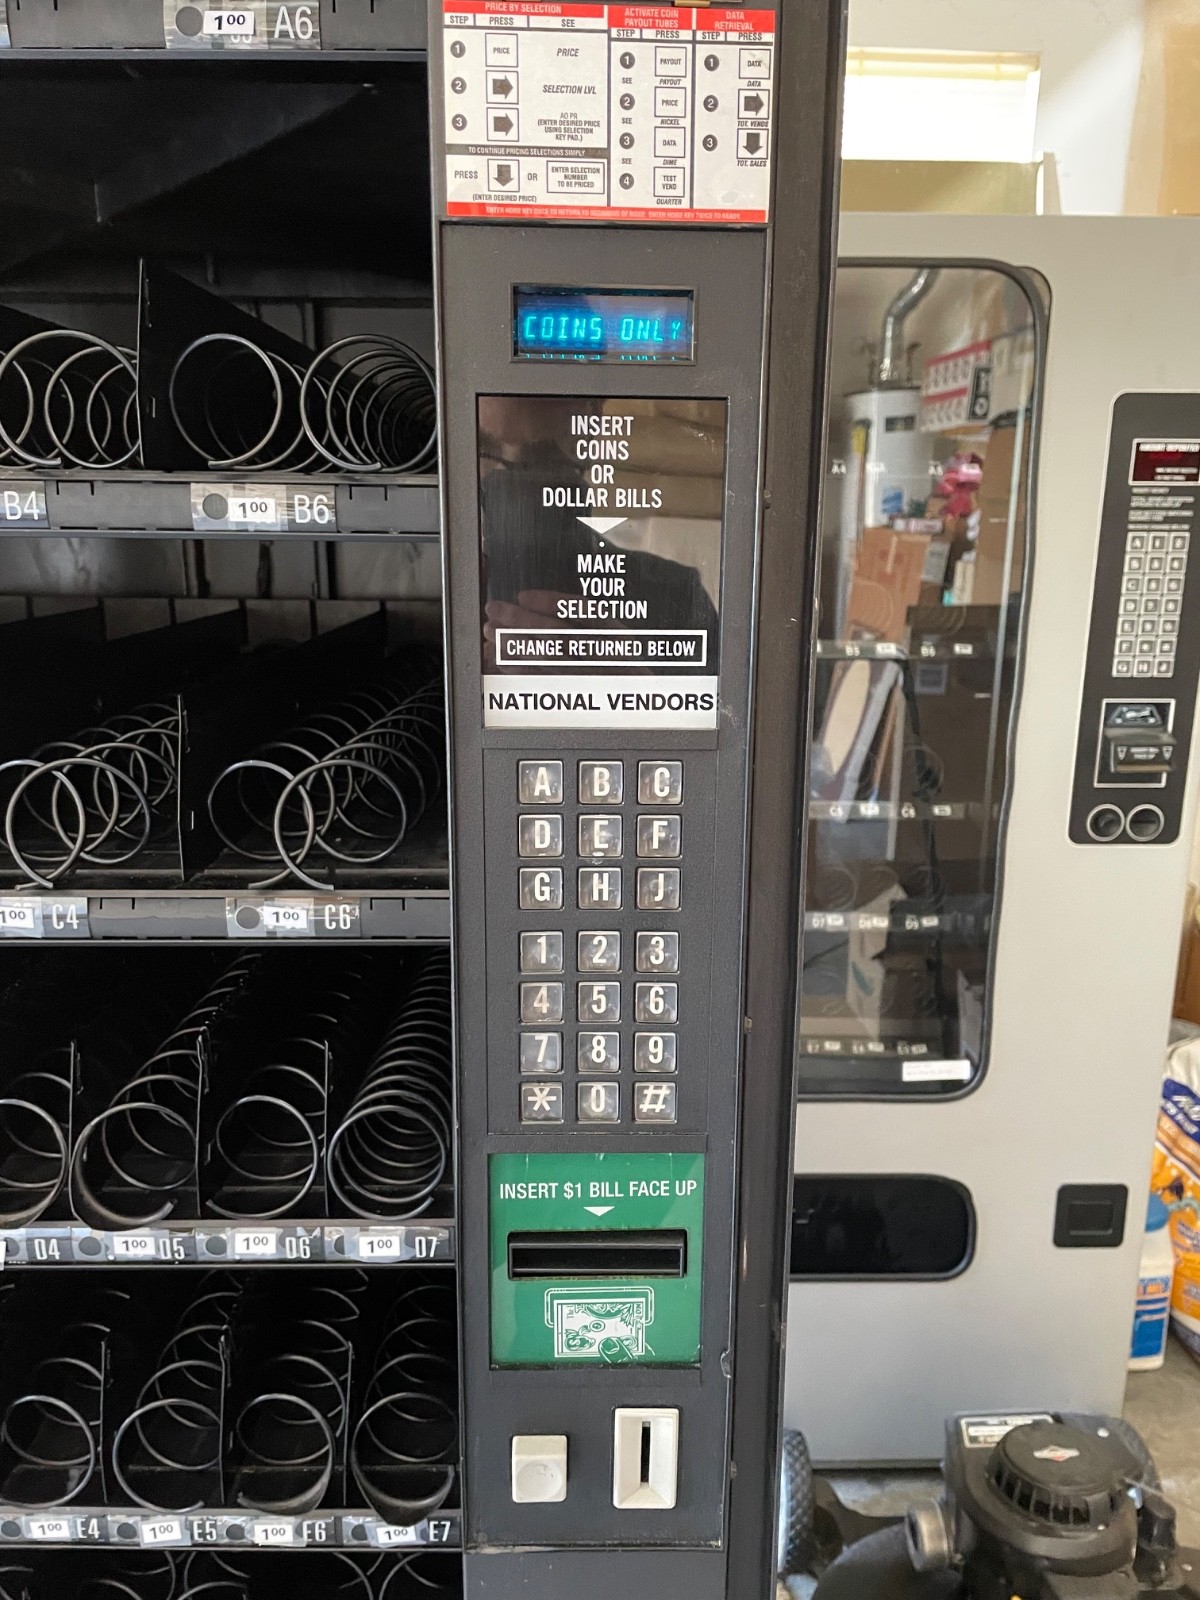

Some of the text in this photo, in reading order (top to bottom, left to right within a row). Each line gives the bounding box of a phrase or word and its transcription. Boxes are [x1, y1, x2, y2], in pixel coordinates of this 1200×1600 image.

[485, 2, 562, 14] PRICE BY SELECTION
[624, 8, 679, 18] ACTIVATE COIN
[726, 11, 745, 20] DATA
[273, 5, 313, 40] A6
[450, 15, 469, 24] STEP
[489, 17, 514, 26] PRESS
[561, 19, 576, 28] SEE
[624, 18, 679, 28] PAYOUT TUBES
[714, 22, 754, 31] RETRIEVAL
[616, 28, 635, 38] STEP
[655, 30, 680, 39] PRESS
[702, 31, 721, 40] STEP
[738, 32, 763, 41] PRESS
[556, 48, 580, 57] PRICE
[747, 60, 762, 68] DATA
[542, 84, 597, 95] SELECTION LVL
[659, 78, 682, 86] PAYOUT
[661, 99, 679, 107] PRICE
[660, 118, 680, 126] NICKEL
[468, 146, 586, 157] TO CONTINUE PRICING SELECTIONS SIMPLY
[662, 139, 677, 147] DATA
[621, 157, 632, 165] SEE
[454, 170, 479, 180] PRESS
[527, 172, 538, 181] OR
[557, 180, 565, 188] TO
[662, 175, 677, 183] TEST
[661, 183, 677, 191] VEND
[472, 193, 537, 203] (ENTER DESIRED PRICE)
[655, 198, 683, 206] QUARTER
[523, 316, 681, 342] COINS ONLY
[571, 415, 634, 436] INSERT
[576, 440, 630, 460] COINS
[591, 464, 615, 484] OR
[4, 490, 40, 521] B4
[542, 487, 663, 508] DOLLAR BILLS
[294, 494, 330, 524] B6
[577, 554, 627, 574] MAKE
[579, 577, 626, 597] YOUR
[556, 600, 648, 619] SELECTION
[506, 639, 696, 657] CHANGE RETURNED BELOW
[488, 693, 715, 711] NATIONAL VENDORS
[533, 766, 552, 797] A
[593, 767, 611, 797] B
[653, 767, 671, 798] C
[534, 819, 551, 849] D
[593, 820, 609, 849] E
[652, 820, 669, 850] F
[533, 872, 551, 902] G
[592, 872, 609, 901] H
[654, 873, 665, 902] J
[52, 904, 79, 930] C4
[324, 904, 351, 930] C6
[536, 935, 547, 964] 1
[592, 935, 608, 964] 2
[649, 936, 665, 965] 3
[533, 985, 550, 1014] 4
[591, 985, 607, 1014] 5
[649, 986, 665, 1015] 6
[534, 1035, 549, 1063] 7
[591, 1035, 606, 1064] 8
[648, 1036, 664, 1064] 9
[590, 1085, 606, 1113] 0
[639, 1084, 671, 1113] #
[499, 1180, 697, 1200] INSERT $1 BILL FACE UP
[77, 1517, 100, 1539] E4
[193, 1519, 217, 1541] E5
[302, 1520, 326, 1542] E6
[429, 1520, 451, 1542] E7
